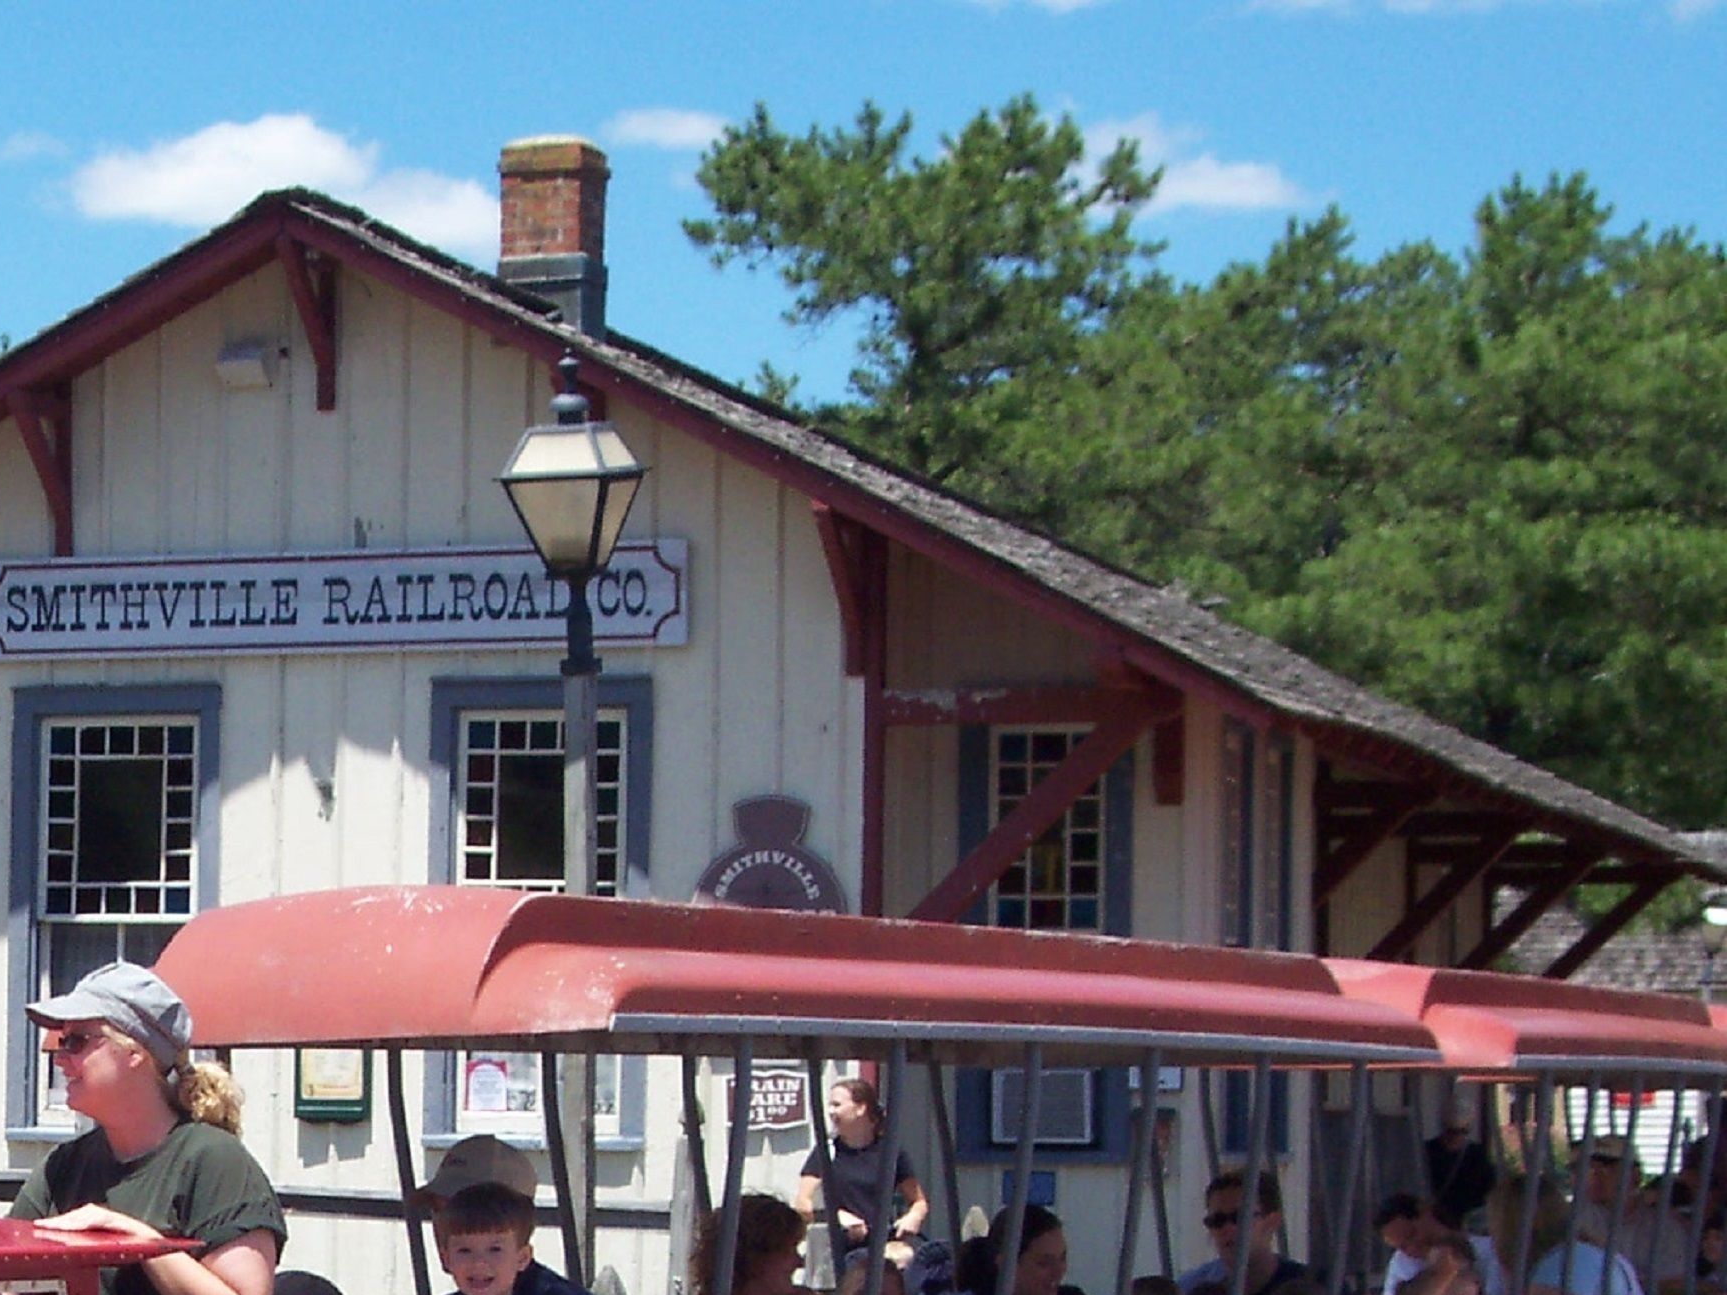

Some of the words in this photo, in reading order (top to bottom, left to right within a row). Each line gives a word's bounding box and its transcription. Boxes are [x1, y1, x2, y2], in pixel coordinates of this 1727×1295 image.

[6, 578, 298, 633] SMITHVILLE
[323, 571, 572, 625] RAILROAD
[597, 568, 652, 617] CO.
[714, 850, 821, 900] SMITHVILLE
[749, 1092, 798, 1106] ARE
